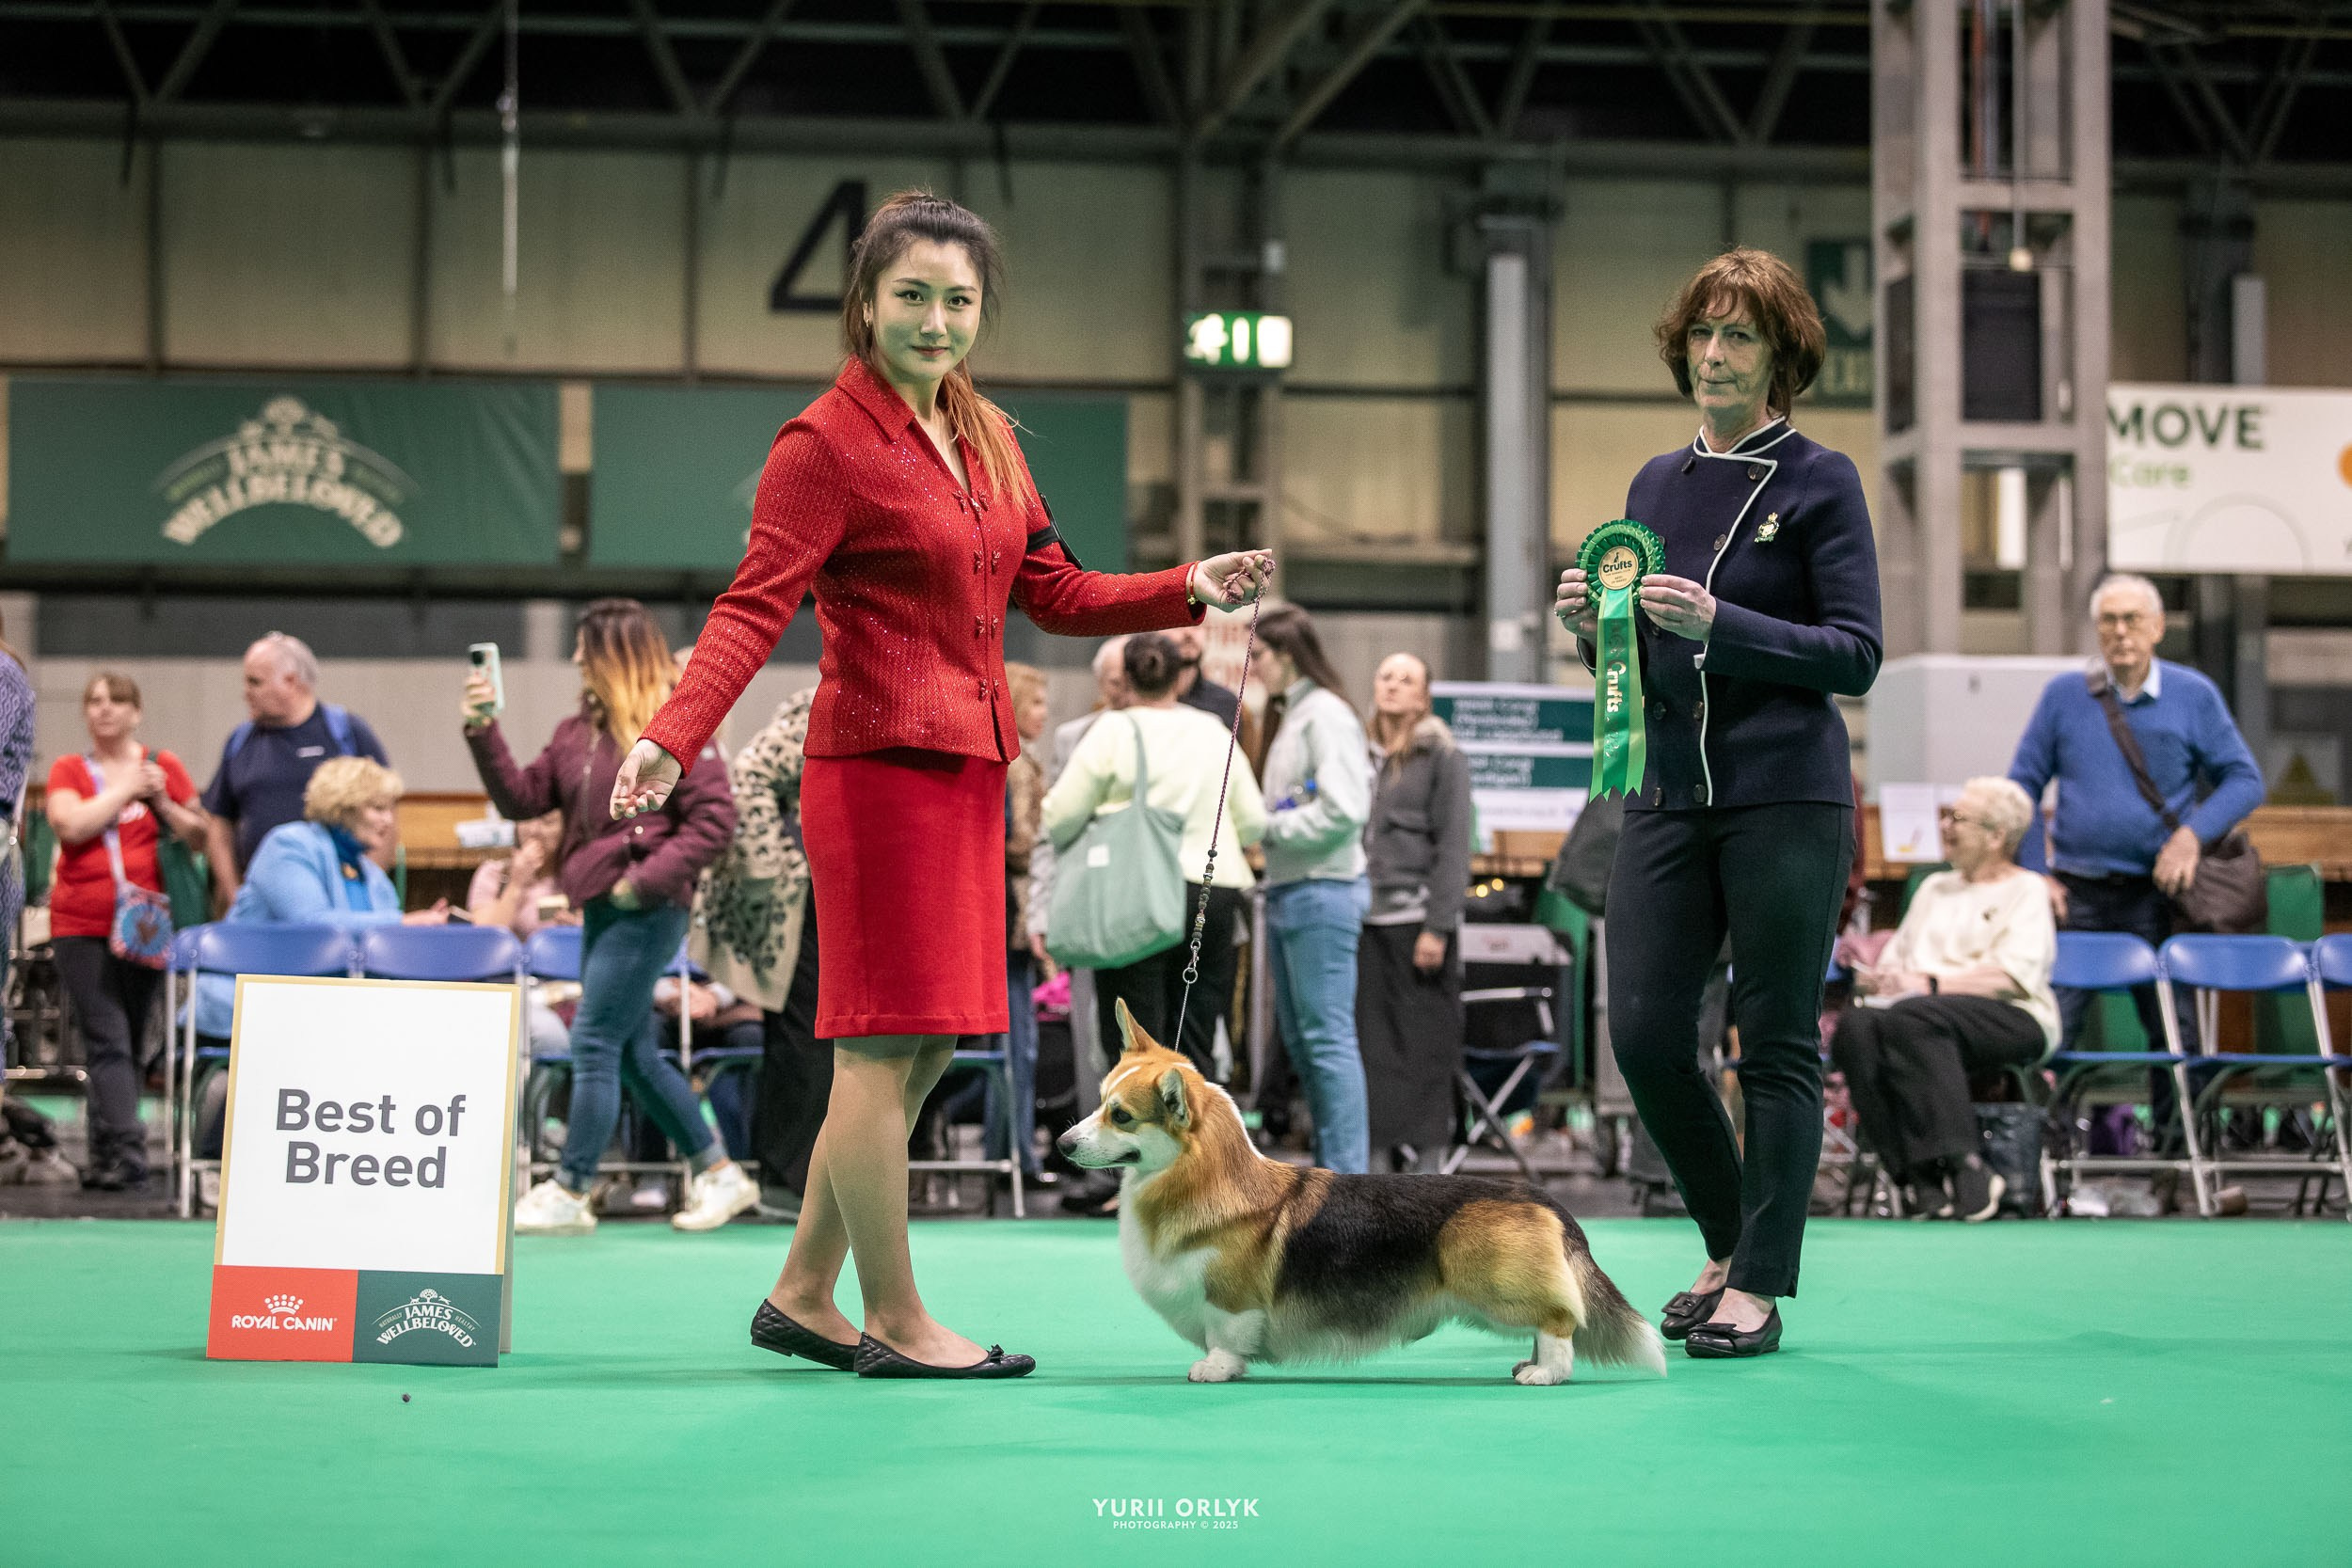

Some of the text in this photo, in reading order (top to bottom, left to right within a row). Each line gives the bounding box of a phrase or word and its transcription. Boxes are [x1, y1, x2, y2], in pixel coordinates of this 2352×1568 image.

[2107, 403, 2266, 451] MOVE
[1602, 561, 1632, 574] Crufts
[1607, 659, 1627, 713] Crufts
[276, 1088, 467, 1137] Best of
[285, 1140, 447, 1189] Breed
[231, 1315, 280, 1329] ROYAL
[405, 1305, 453, 1321] JAMES
[376, 1318, 473, 1348] WELLBELOVED
